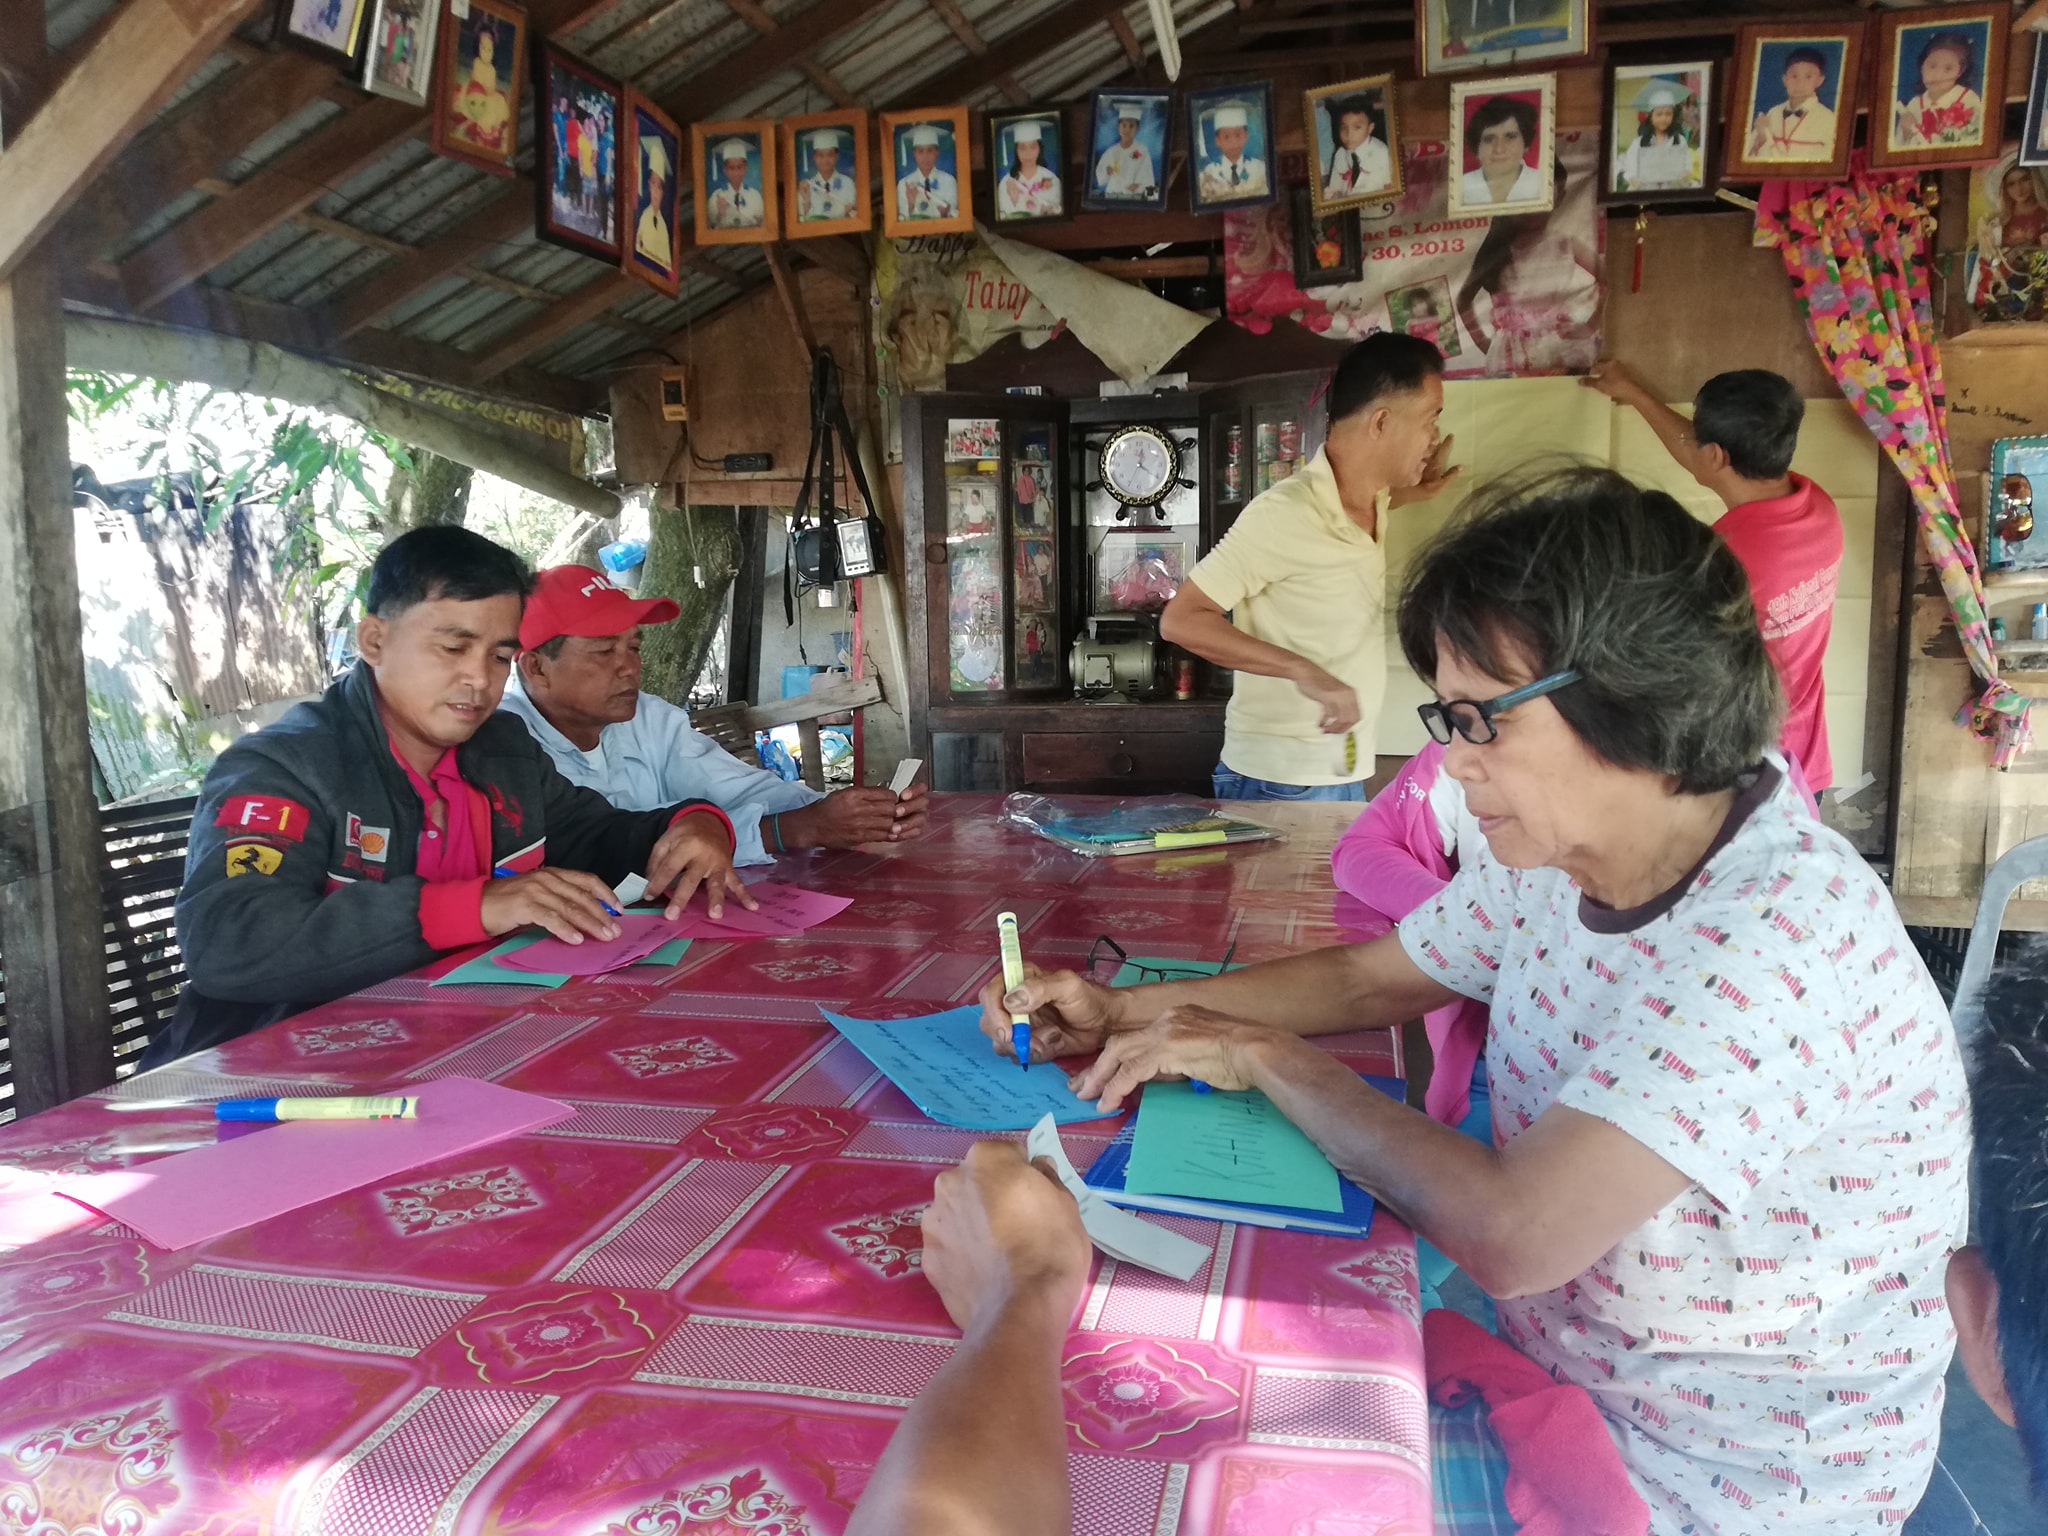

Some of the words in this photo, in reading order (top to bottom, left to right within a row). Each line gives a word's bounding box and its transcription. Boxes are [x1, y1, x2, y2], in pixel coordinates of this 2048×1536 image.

[1388, 224, 1409, 242] S.
[1413, 216, 1489, 237] Lomon
[1370, 245, 1406, 264] 30,
[1410, 238, 1466, 257] 2013
[965, 270, 1031, 321] Tatay
[240, 800, 292, 832] F-1
